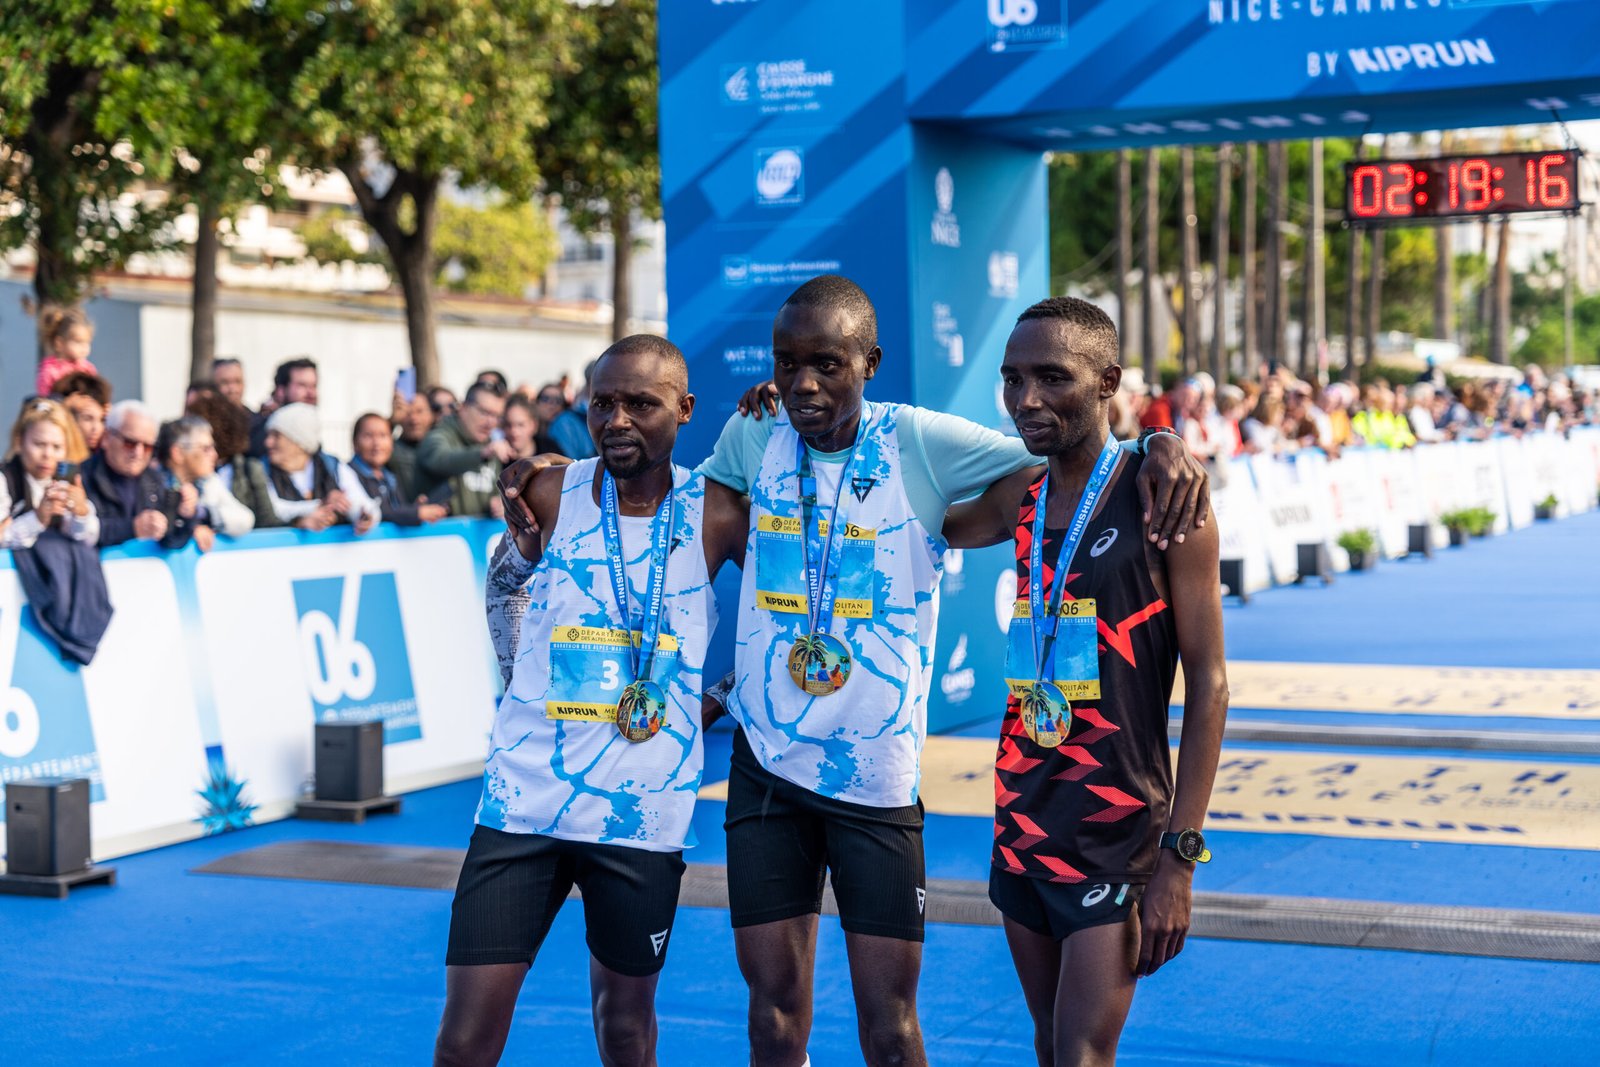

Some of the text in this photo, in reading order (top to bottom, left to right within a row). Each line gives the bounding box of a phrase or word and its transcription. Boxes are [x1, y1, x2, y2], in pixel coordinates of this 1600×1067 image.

[1307, 38, 1495, 77] BY KIPRUN
[1352, 154, 1569, 217] 02:19:16
[1069, 491, 1096, 542] FINISHER
[613, 555, 625, 605] FINISHER
[650, 565, 664, 616] FINISHER
[765, 596, 798, 608] KIPRUN
[1062, 602, 1079, 615] 06
[300, 574, 377, 706] 06
[600, 660, 619, 690] 3
[557, 707, 598, 717] KIPRUN
